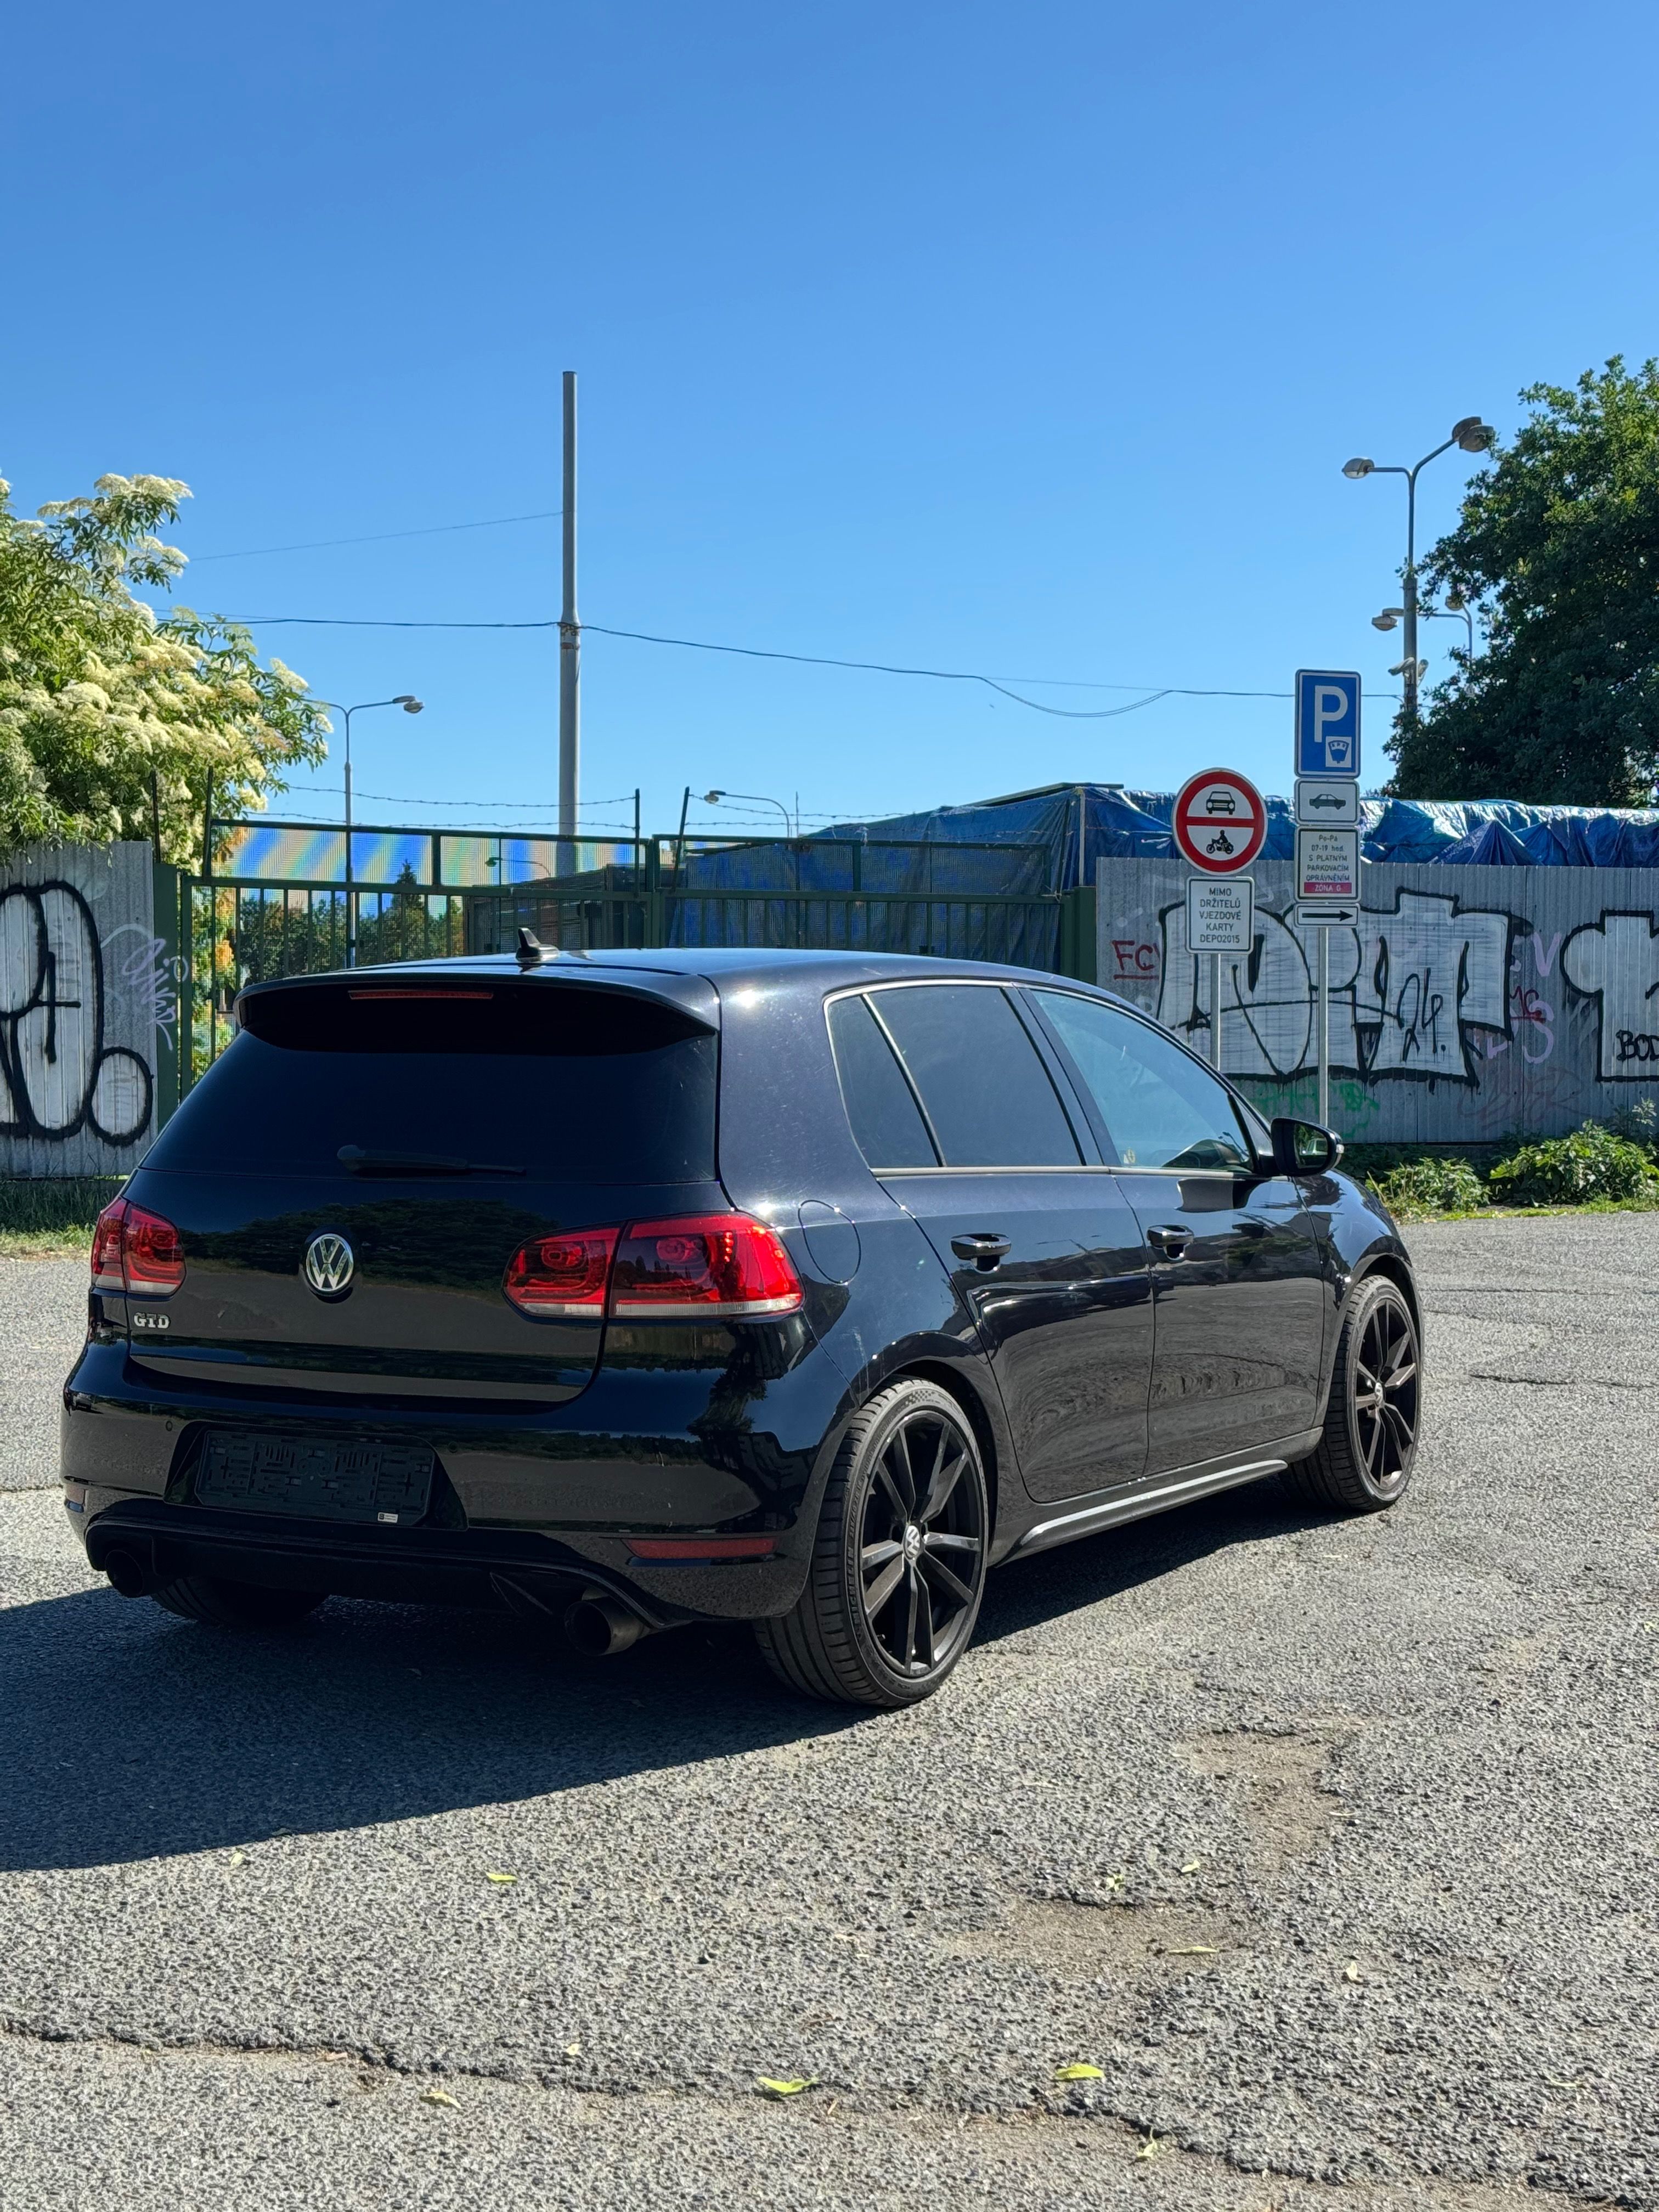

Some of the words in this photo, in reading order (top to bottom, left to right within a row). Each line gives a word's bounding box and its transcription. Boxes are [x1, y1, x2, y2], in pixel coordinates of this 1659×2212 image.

[1314, 685, 1348, 743] P
[1317, 853, 1347, 861] PLATNÝM
[1209, 887, 1232, 896] MIMO
[1200, 898, 1240, 908] DRŽITELŮ
[1199, 910, 1242, 921] VJEZDOVÉ
[1206, 922, 1234, 932] KARTY
[1200, 934, 1240, 943] DEPO2015
[134, 1312, 170, 1329] GTD
[848, 1547, 859, 1625] MICHELIN
